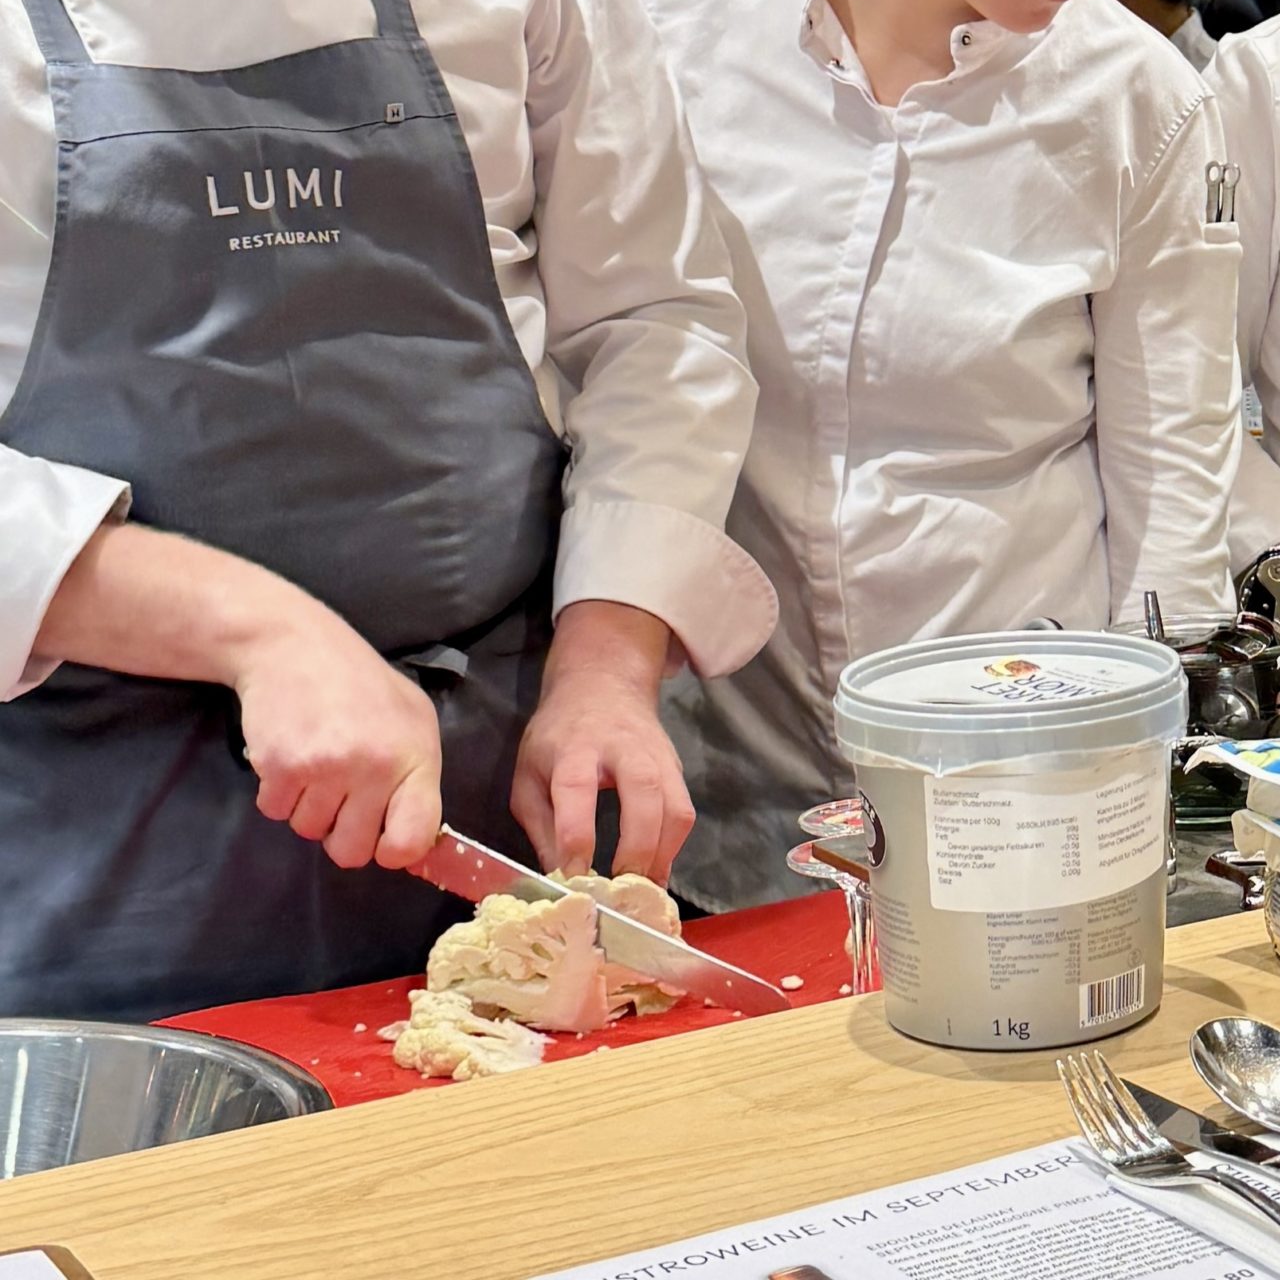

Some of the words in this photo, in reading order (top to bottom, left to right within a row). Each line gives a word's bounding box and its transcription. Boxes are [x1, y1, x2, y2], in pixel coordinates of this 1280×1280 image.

[206, 167, 343, 217] LUMI
[229, 229, 341, 251] RESTAURANT
[992, 1018, 1002, 1037] 1
[1008, 1017, 1031, 1040] kg
[603, 1223, 826, 1280] STROWEINE
[832, 1209, 879, 1229] IM
[886, 1153, 1082, 1214] SEPTEMBER
[864, 1227, 940, 1251] EDOUARD
[939, 1206, 1019, 1230] DELAUNAY
[873, 1230, 963, 1257] SEPTEMBRE
[1051, 1194, 1094, 1209] PINOT
